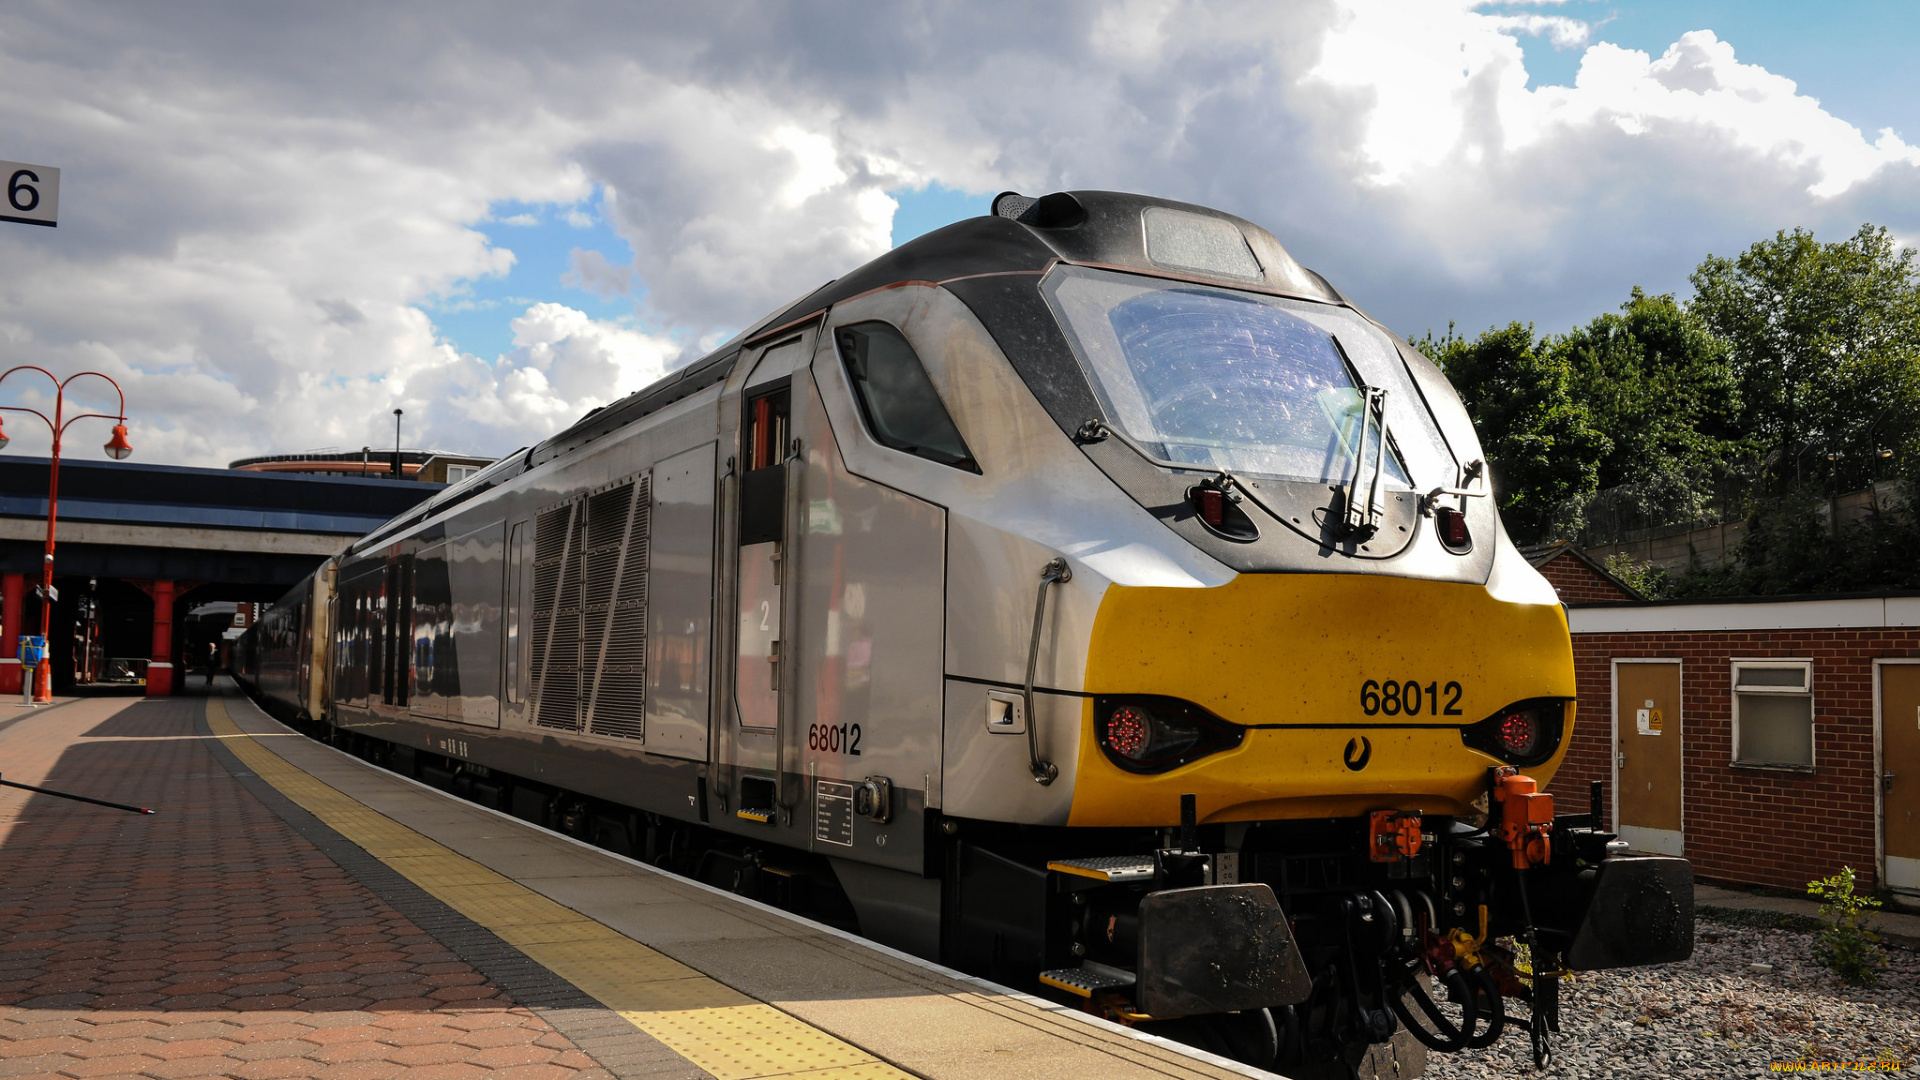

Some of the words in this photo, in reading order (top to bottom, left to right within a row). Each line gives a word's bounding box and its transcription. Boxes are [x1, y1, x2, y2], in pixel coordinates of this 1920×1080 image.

[8, 169, 40, 212] 6
[760, 600, 770, 631] 2
[1360, 679, 1463, 716] 68012
[808, 722, 862, 756] 68012
